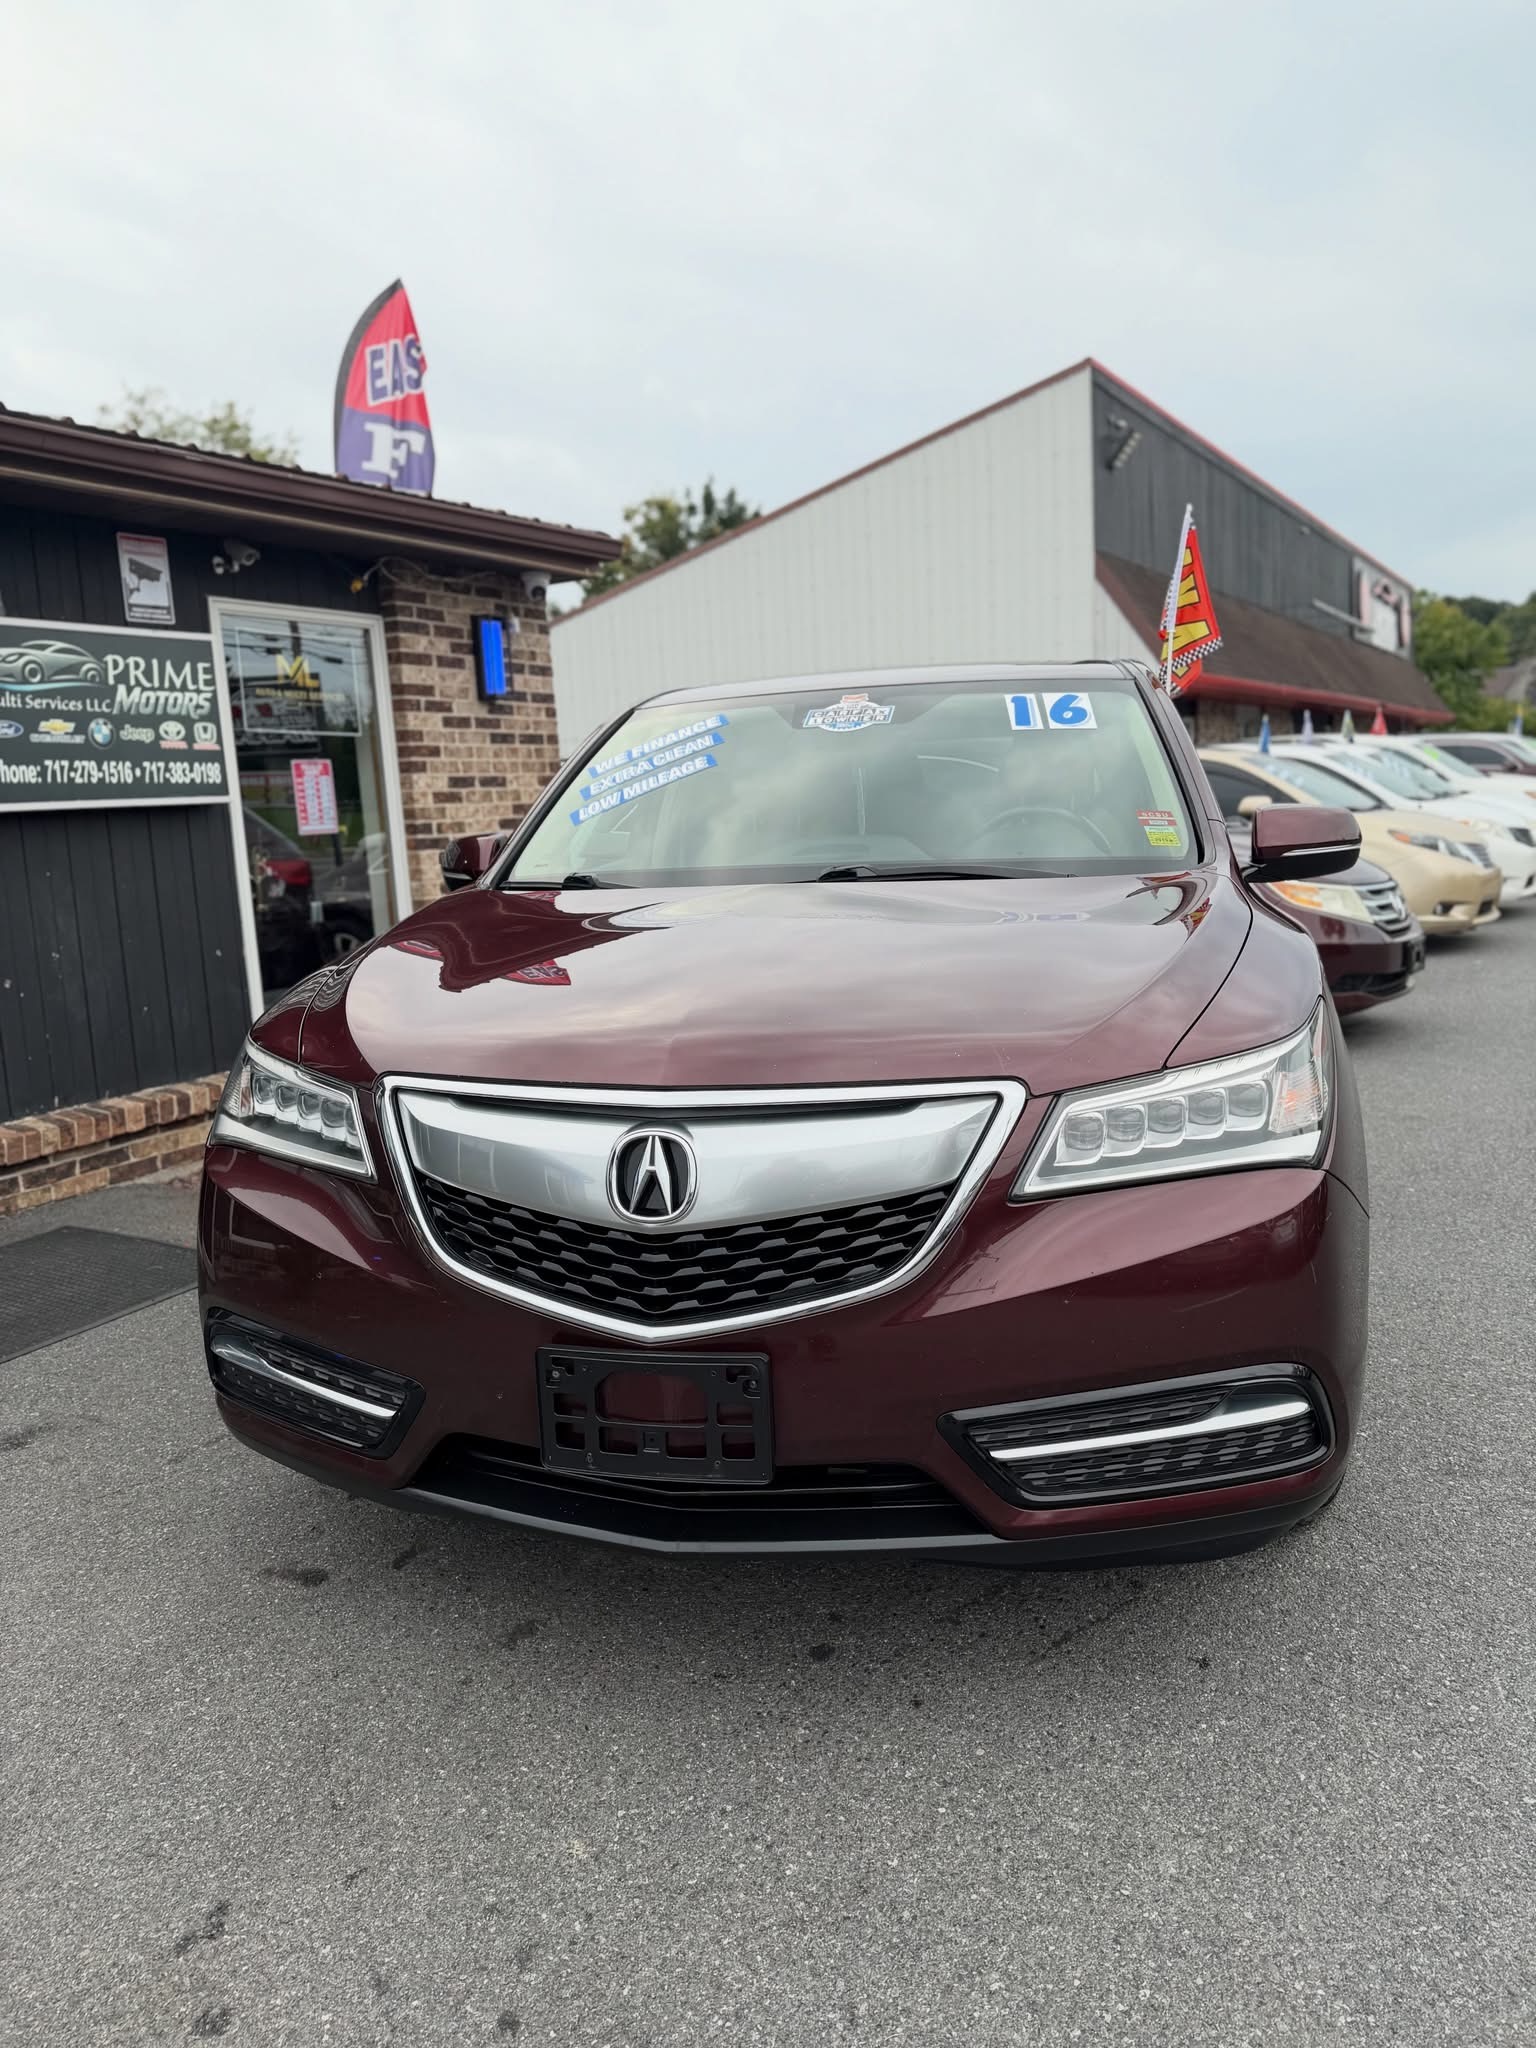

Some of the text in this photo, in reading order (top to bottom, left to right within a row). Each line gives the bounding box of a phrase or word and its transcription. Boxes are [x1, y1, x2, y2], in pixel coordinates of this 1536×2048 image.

[104, 654, 216, 691] PRIME
[25, 694, 83, 712] Services
[86, 698, 112, 713] LLC
[112, 683, 213, 720] MOTORS
[119, 723, 155, 743] Jeep
[595, 715, 722, 775] WE FINANCE
[589, 734, 715, 796] EXTRA CLEAN
[578, 755, 709, 822] LOW MILEAGE
